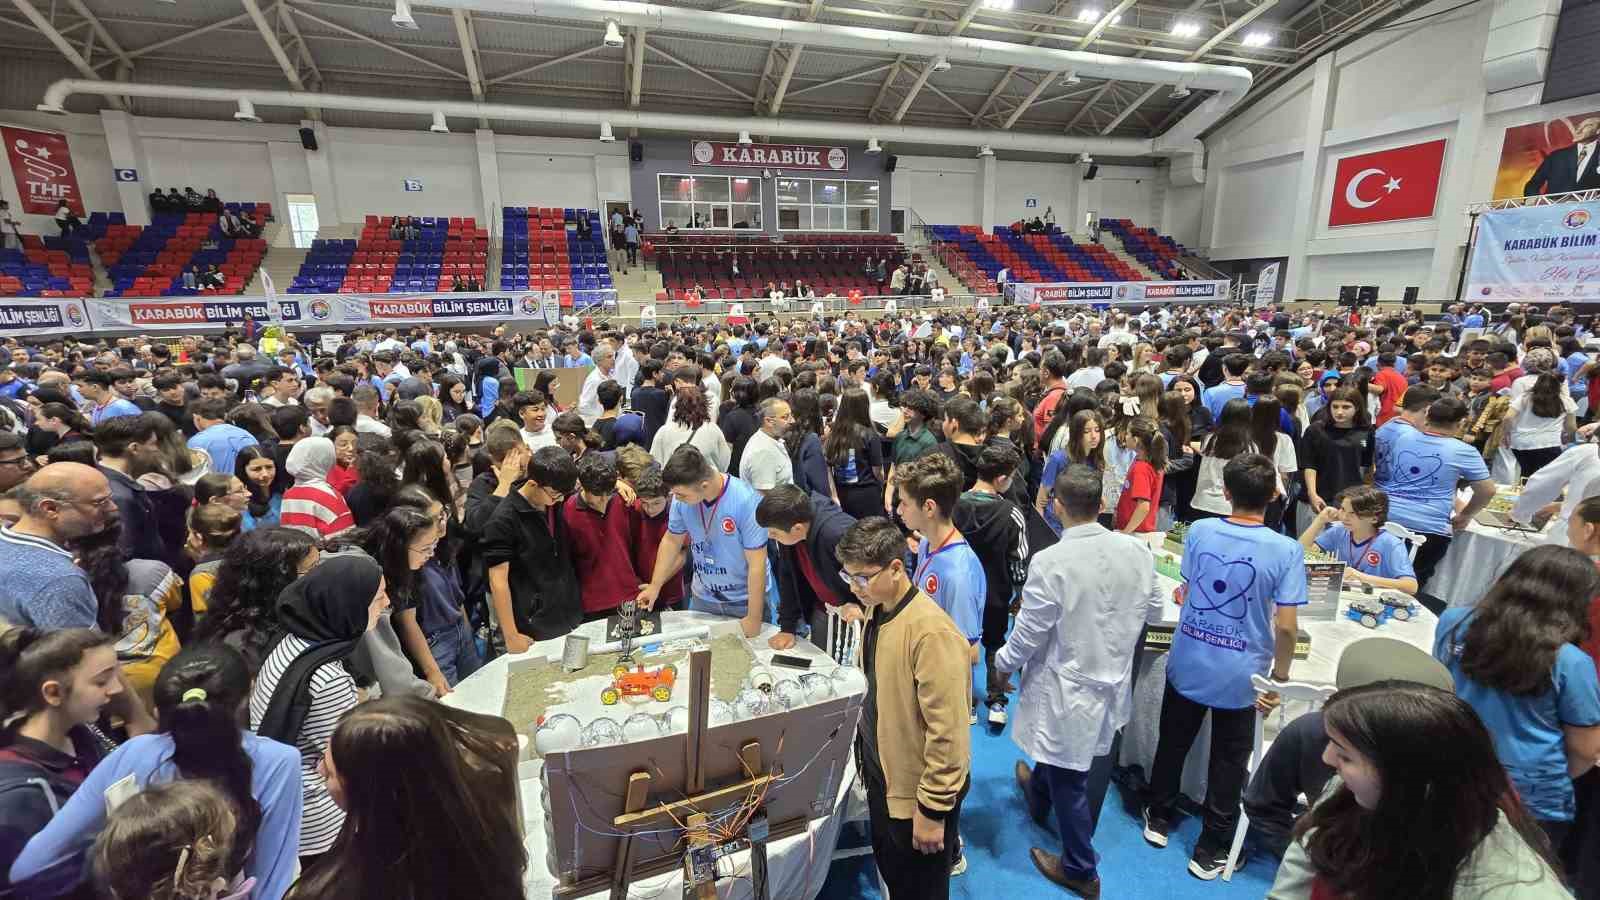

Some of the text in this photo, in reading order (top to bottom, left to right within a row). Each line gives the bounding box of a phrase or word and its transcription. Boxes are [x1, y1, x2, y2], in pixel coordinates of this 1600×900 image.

[722, 147, 821, 166] KARABÜK
[120, 170, 135, 181] C
[25, 181, 72, 197] THF
[408, 180, 421, 191] B
[1504, 232, 1597, 251] KARABÜK BİLİM
[1068, 287, 1085, 298] BİLİM
[1147, 286, 1175, 296] KARABÜK
[133, 305, 205, 320] KARABÜK
[206, 304, 242, 319] BİLİM
[373, 299, 510, 315] KARABÜK BİLİM ŞENLİĞİ
[0, 308, 60, 326] İLİM ŞENLİĞİ
